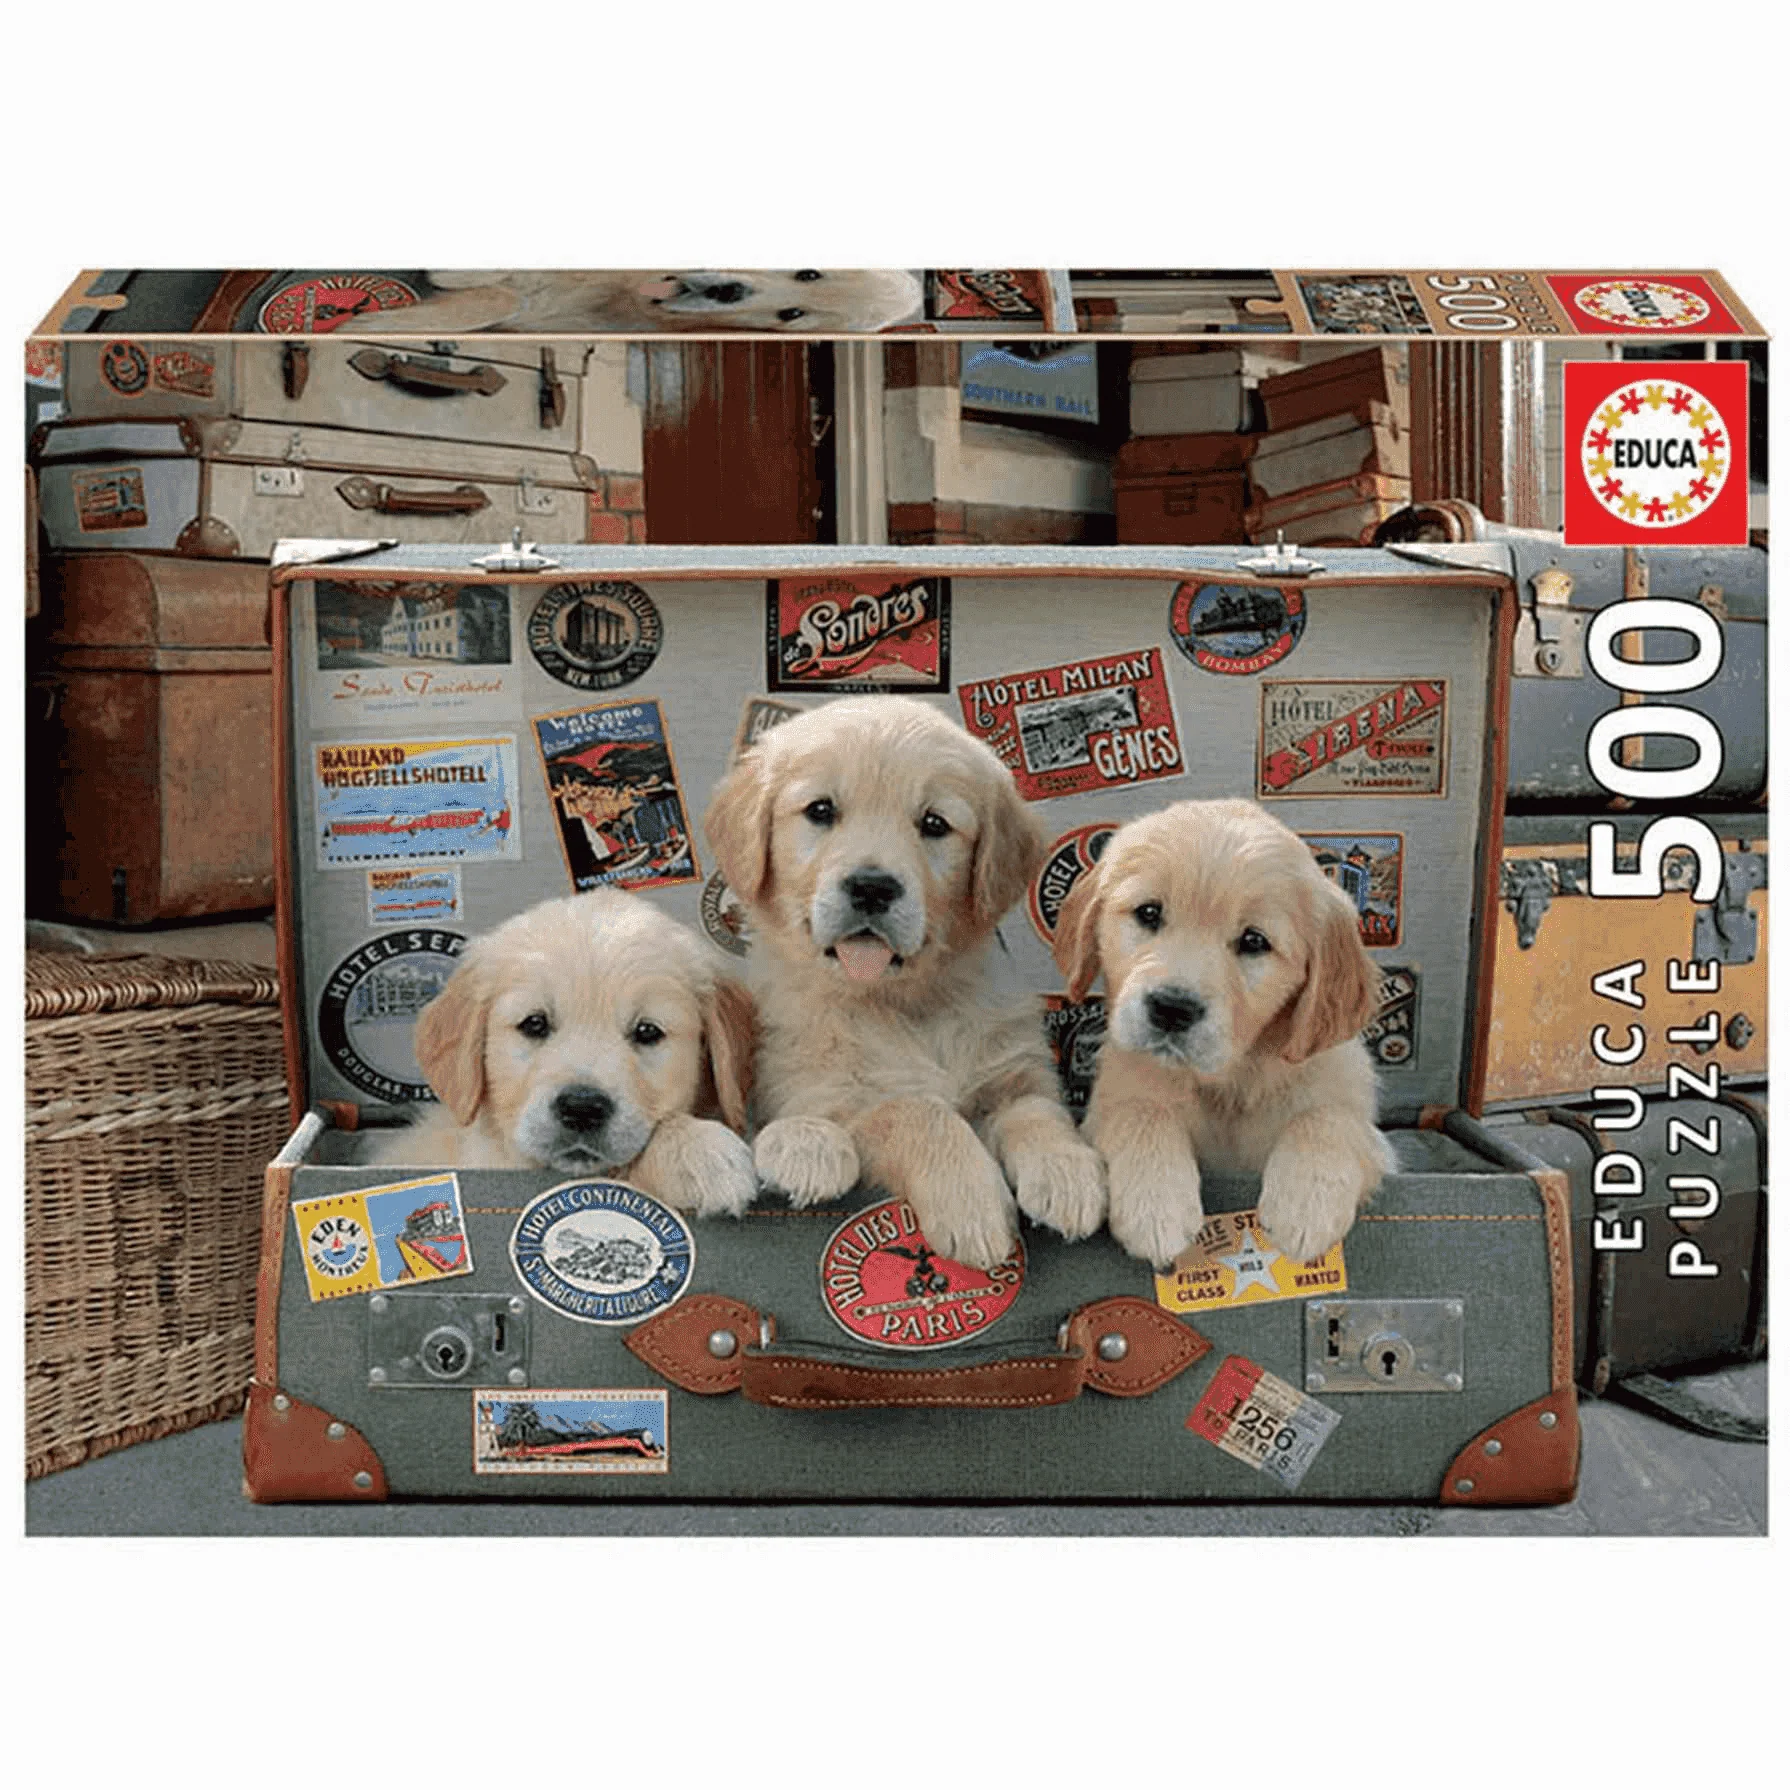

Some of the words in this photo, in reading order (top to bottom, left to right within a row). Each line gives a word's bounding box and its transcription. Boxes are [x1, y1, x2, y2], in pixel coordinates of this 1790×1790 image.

[1427, 275, 1518, 331] 500
[1614, 437, 1697, 469] EDUCA
[970, 676, 1057, 729] HOTEL
[1062, 652, 1153, 694] MILAN
[548, 706, 643, 731] Welcome
[1586, 596, 1725, 903] 500
[1042, 857, 1078, 912] HOTEL
[329, 940, 400, 1000] HOTEL
[408, 932, 466, 953] SEF
[1592, 960, 1646, 1253] EDUCA
[1667, 957, 1720, 1278] PUZZLE
[311, 1217, 361, 1245] EDEN
[521, 1195, 566, 1242] HOTEL
[569, 1187, 676, 1239] CONTINENTAL
[828, 1238, 868, 1309] HOTEL
[854, 1210, 899, 1251] DES
[1177, 1268, 1220, 1286] FIRST
[881, 1299, 986, 1340] PARIS
[1176, 1285, 1226, 1303] CLASS
[1221, 1395, 1298, 1452] 1256
[1232, 1428, 1293, 1470] PARIS
